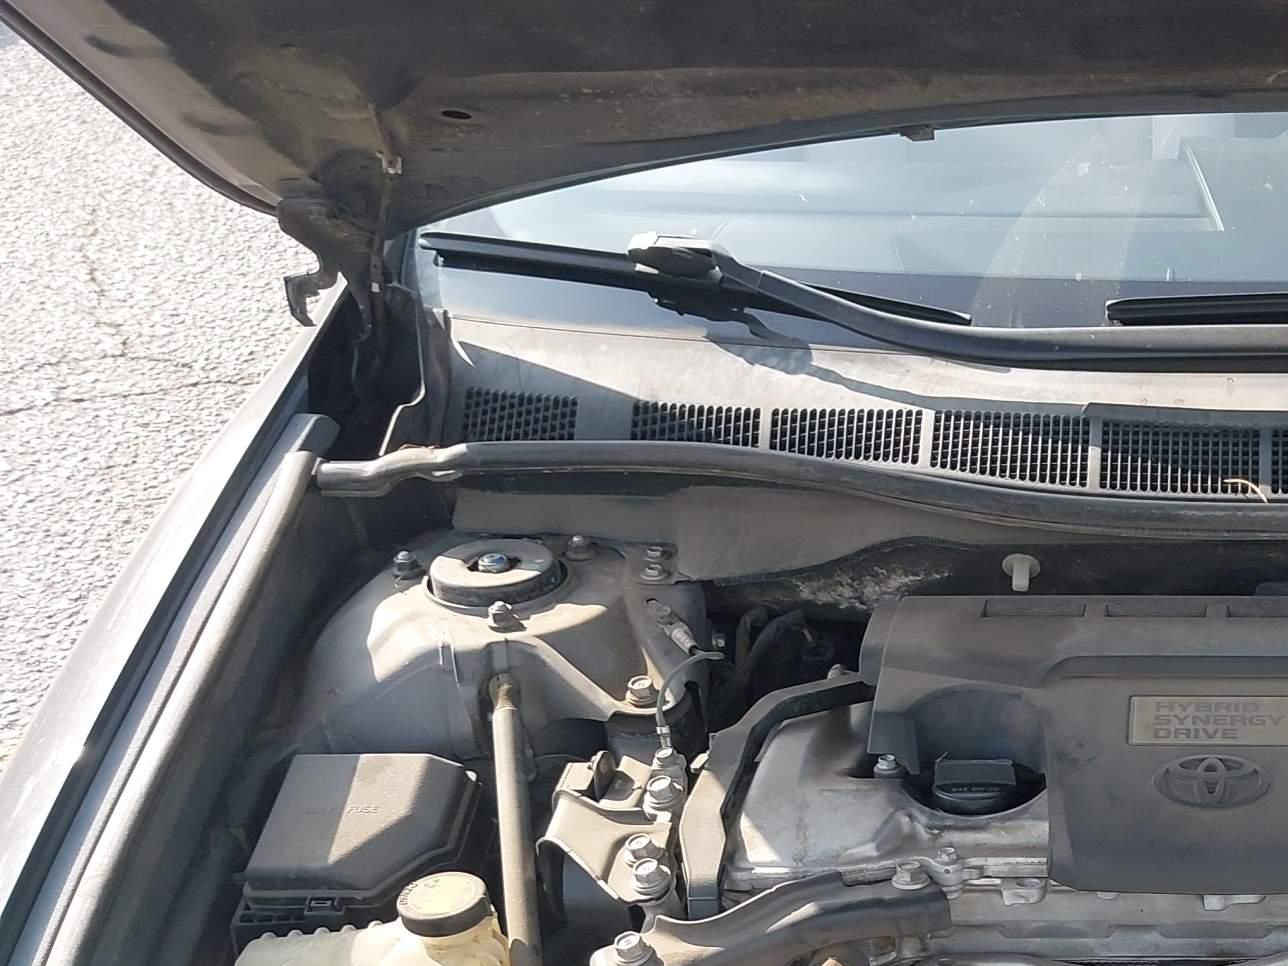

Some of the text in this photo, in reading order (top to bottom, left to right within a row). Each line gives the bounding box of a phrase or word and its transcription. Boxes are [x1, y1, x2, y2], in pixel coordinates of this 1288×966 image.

[1155, 702, 1260, 713] HYBRID
[1153, 714, 1287, 727] SYNERGY
[1153, 727, 1239, 740] DRIVE
[346, 805, 382, 814] FUSE
